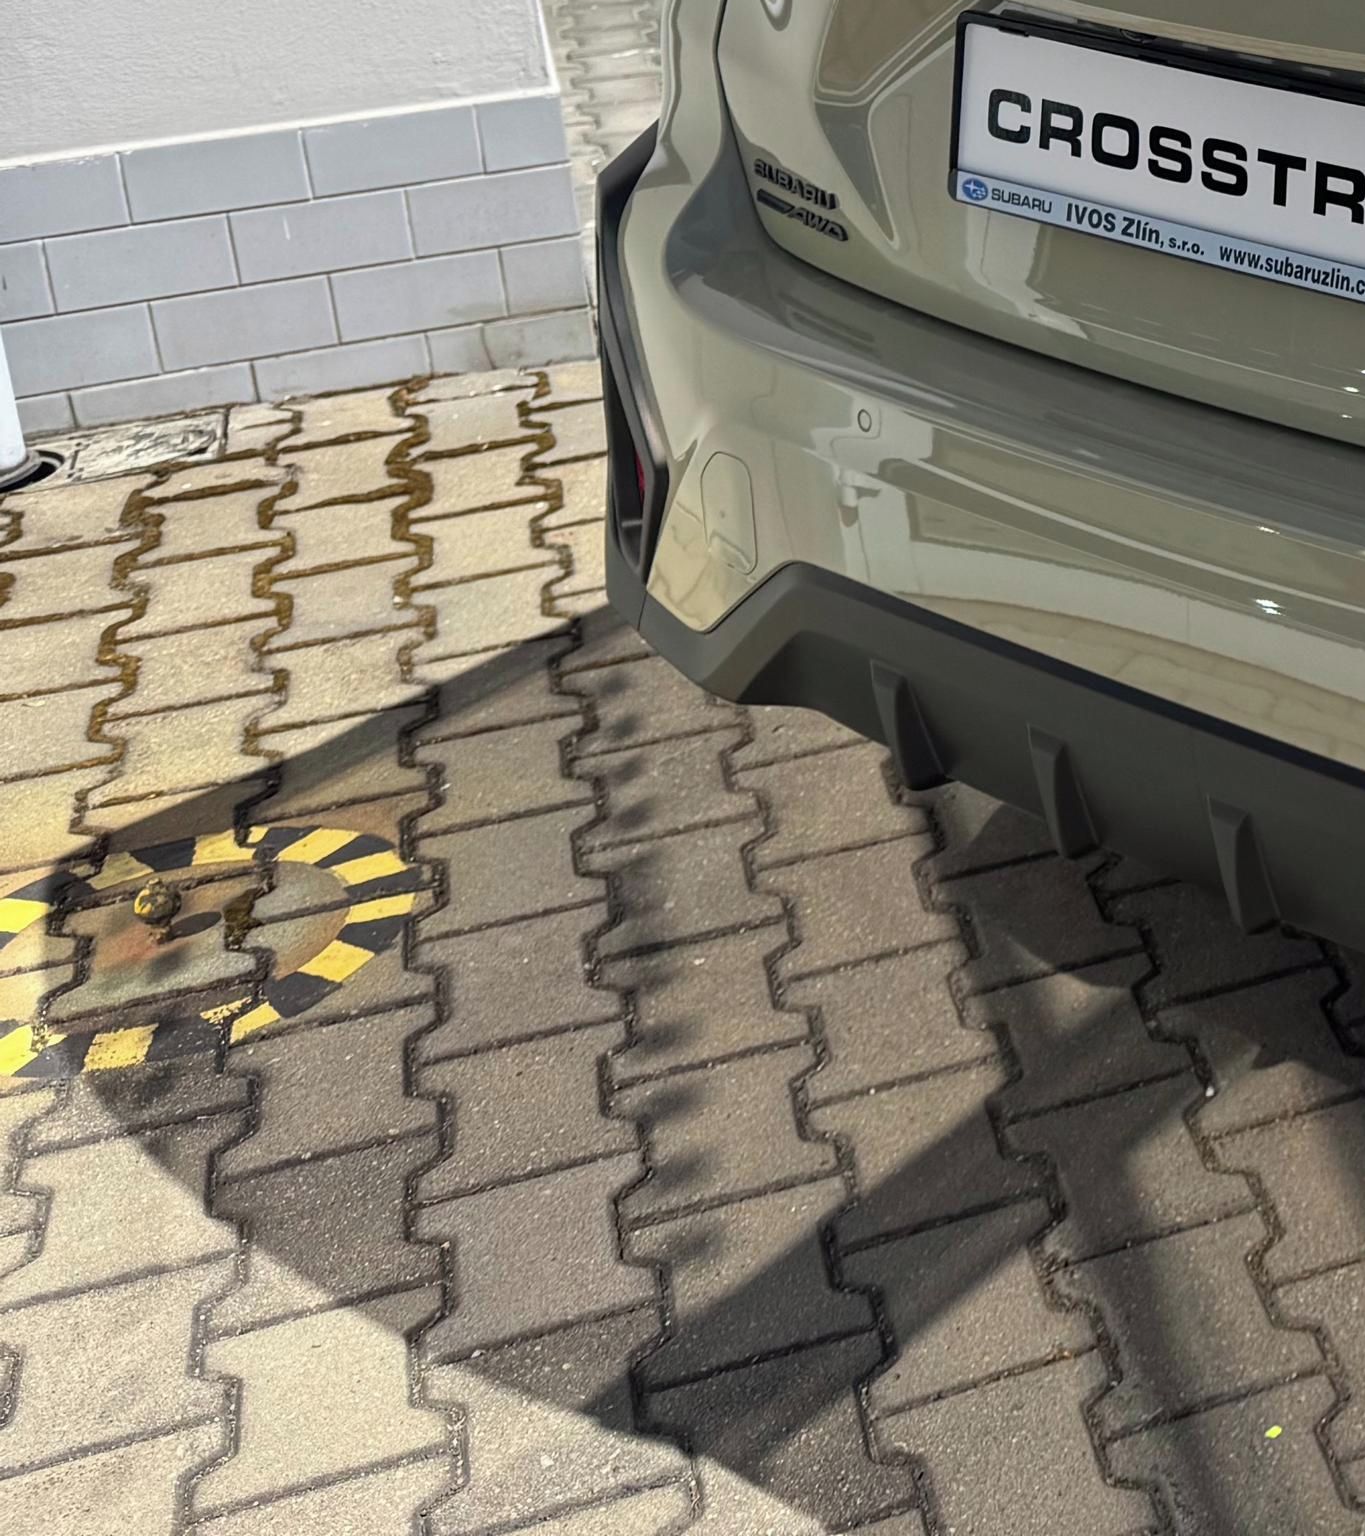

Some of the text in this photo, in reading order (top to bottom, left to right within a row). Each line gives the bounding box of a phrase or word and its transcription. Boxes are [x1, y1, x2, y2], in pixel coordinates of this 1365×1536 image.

[754, 158, 839, 210] SUBARU
[787, 208, 849, 241] AWD
[991, 188, 1052, 213] SUBARU
[1066, 203, 1117, 232] IVOS
[1121, 216, 1164, 248] Zlín,
[1168, 236, 1205, 256] s.r.o.
